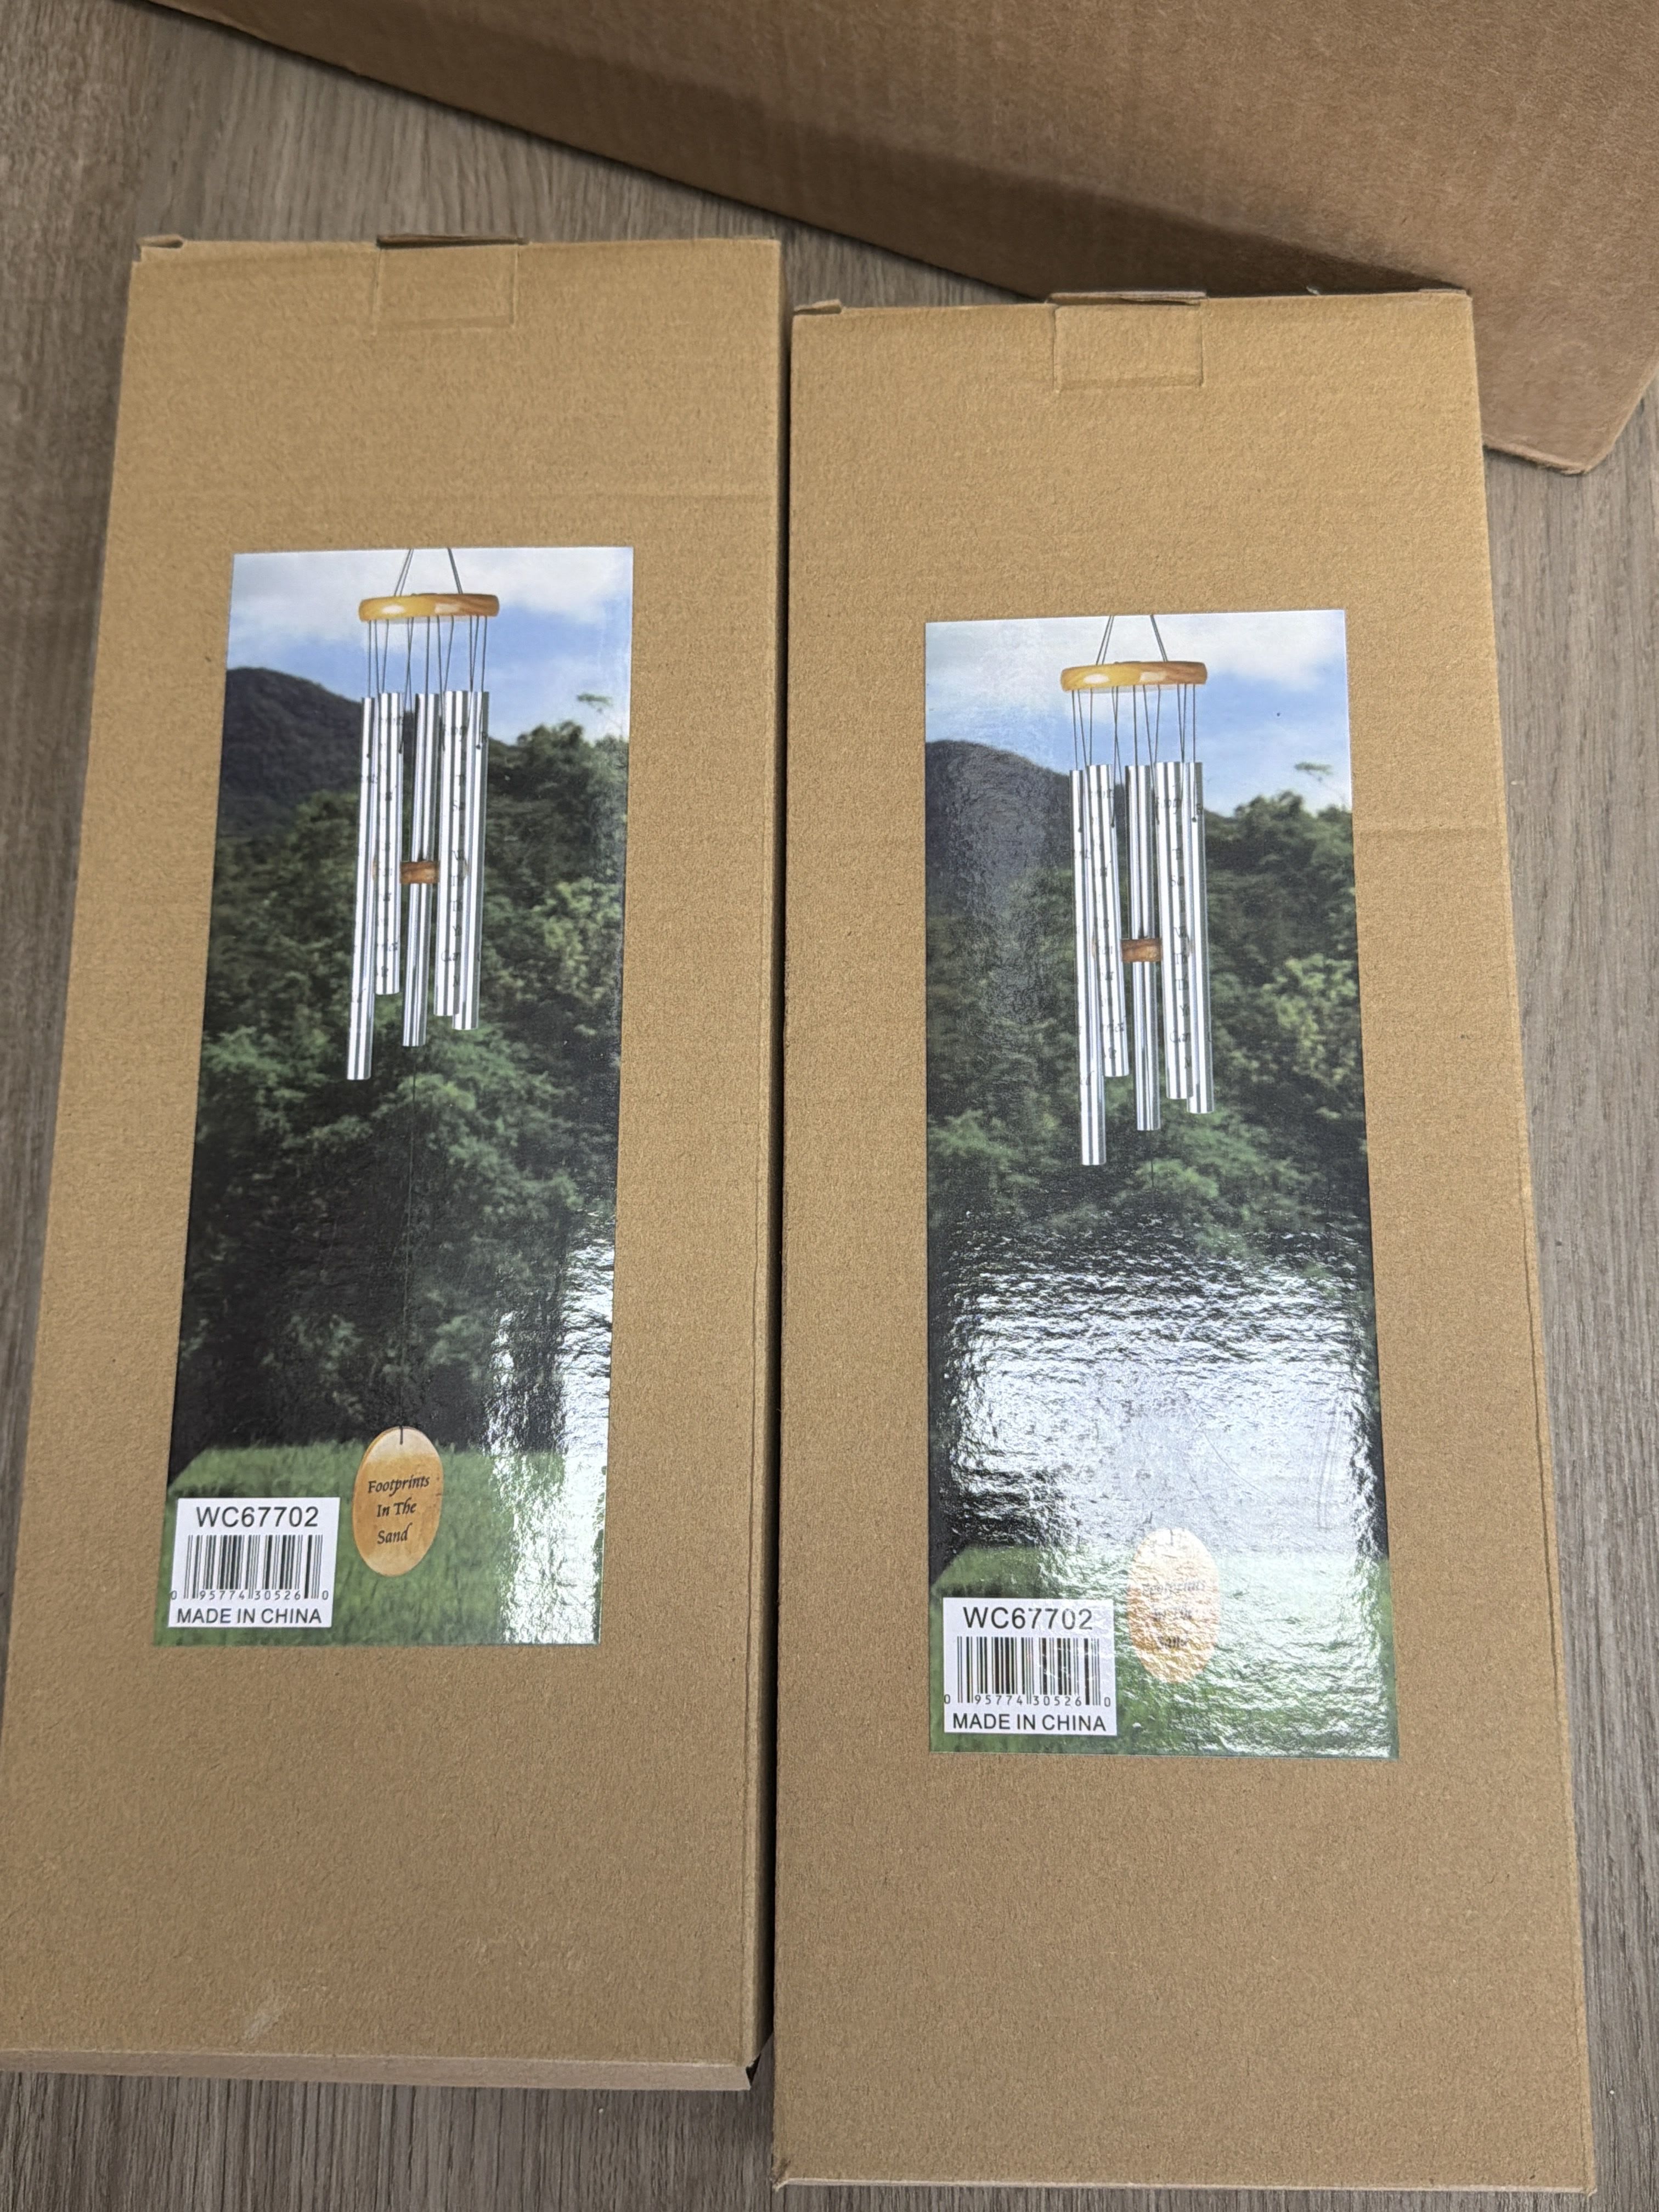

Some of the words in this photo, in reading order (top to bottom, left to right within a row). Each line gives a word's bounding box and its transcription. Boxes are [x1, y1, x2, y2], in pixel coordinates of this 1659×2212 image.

[368, 1475, 430, 1497] Footprints
[196, 1506, 319, 1527] WC67702
[376, 1504, 390, 1517] In
[393, 1497, 417, 1515] The
[377, 1522, 413, 1544] Sand
[177, 1608, 232, 1623] MADE
[237, 1608, 256, 1623] IN
[261, 1608, 322, 1624] CHINA
[963, 1606, 1093, 1630] WC67702
[953, 1713, 1011, 1729] MADE
[1017, 1714, 1036, 1730] IN
[1042, 1714, 1107, 1731] CHINA
